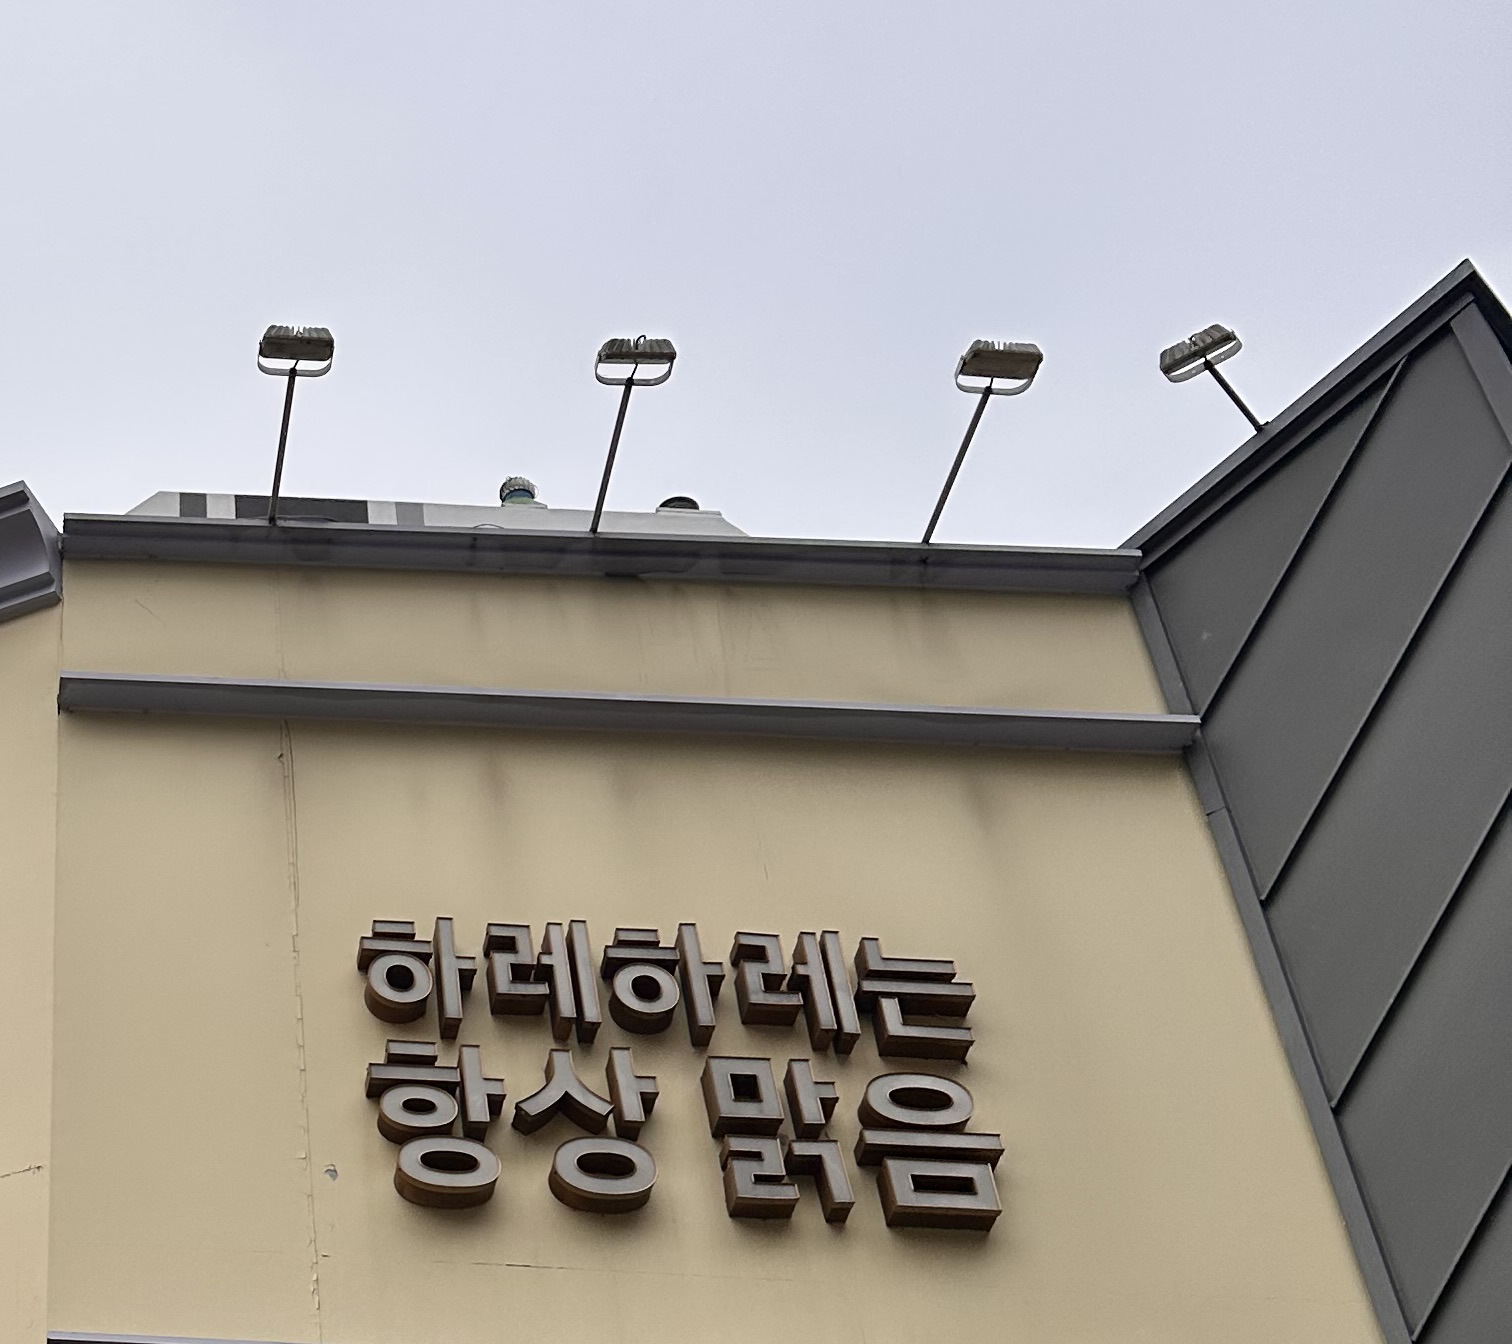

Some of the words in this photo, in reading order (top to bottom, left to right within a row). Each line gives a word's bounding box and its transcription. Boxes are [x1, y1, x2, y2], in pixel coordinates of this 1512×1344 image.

[357, 917, 975, 1063] 하레하레는
[366, 1038, 659, 1214] 항상
[700, 1056, 1005, 1231] 맑음
